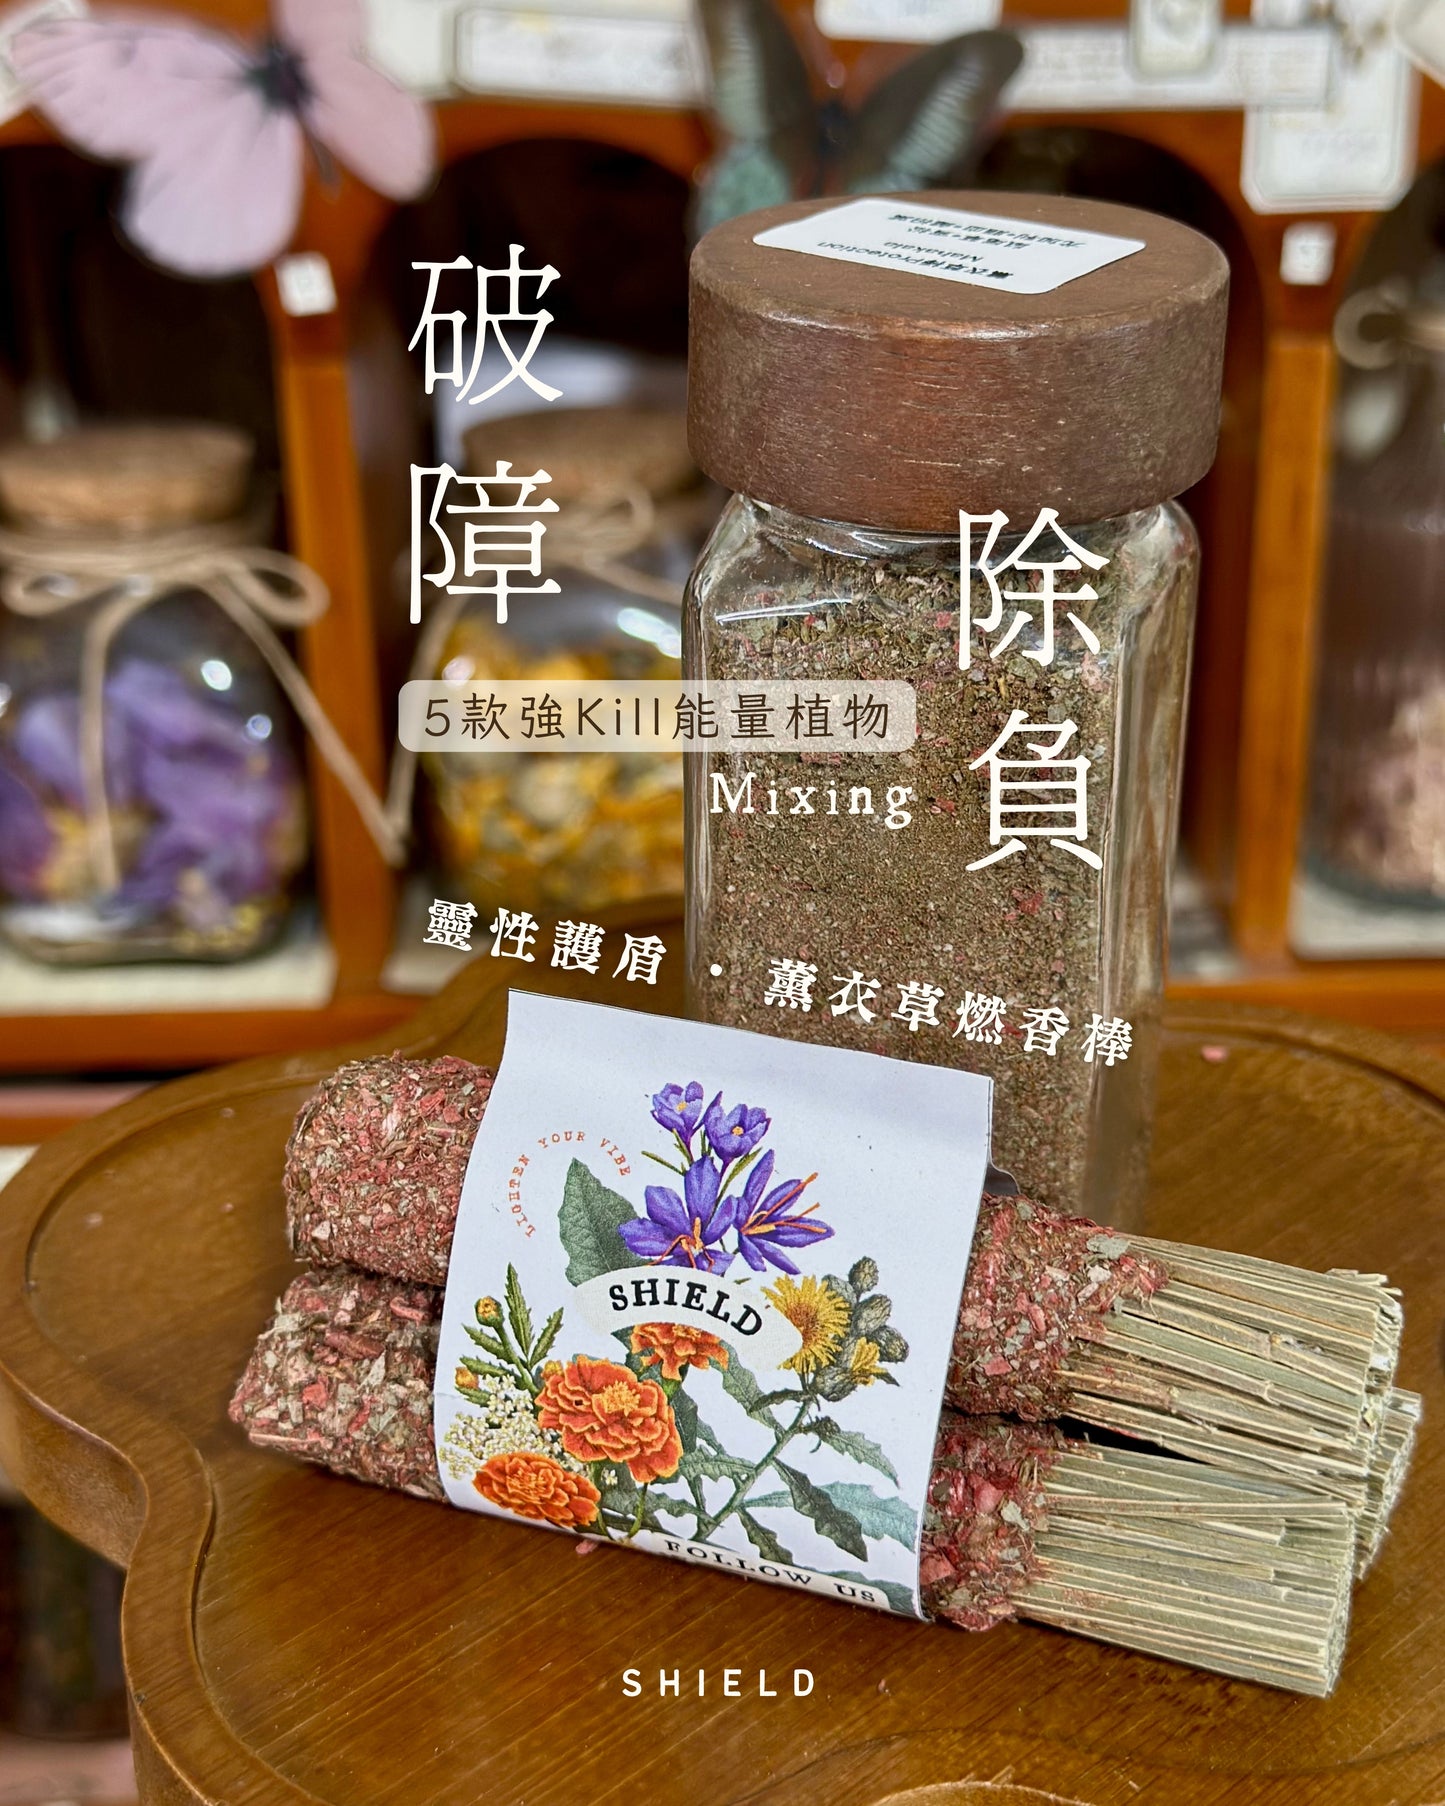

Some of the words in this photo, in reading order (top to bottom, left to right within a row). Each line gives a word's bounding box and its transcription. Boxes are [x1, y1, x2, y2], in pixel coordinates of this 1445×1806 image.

[882, 241, 984, 262] Mahakala
[508, 1154, 536, 1238] LIGHTEN
[537, 1130, 586, 1149] YOUR
[600, 1137, 631, 1176] VIBE
[609, 1278, 763, 1336] SHIELD
[664, 1539, 812, 1586] FOLLOW
[834, 1582, 876, 1602] US
